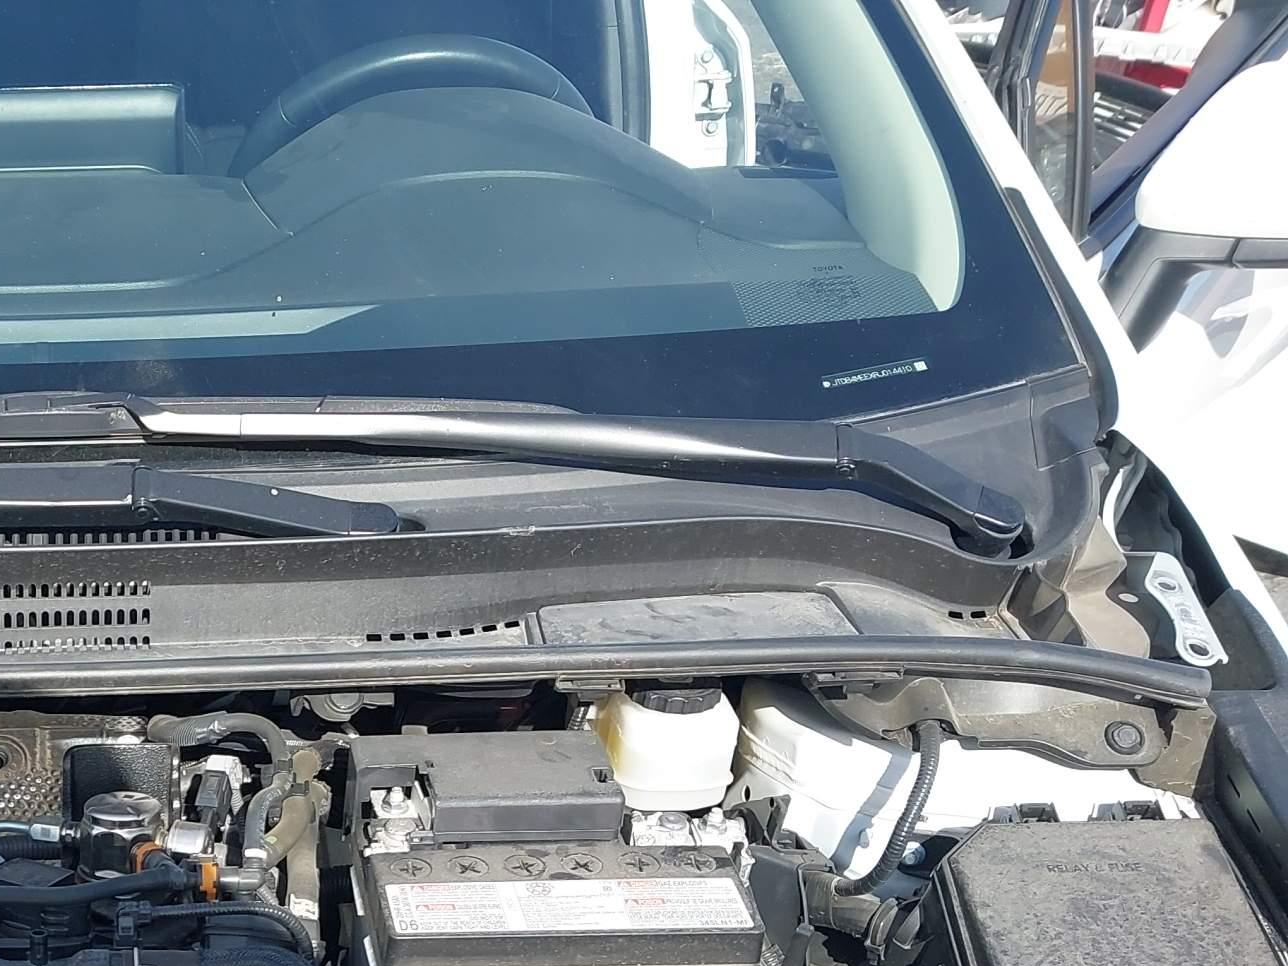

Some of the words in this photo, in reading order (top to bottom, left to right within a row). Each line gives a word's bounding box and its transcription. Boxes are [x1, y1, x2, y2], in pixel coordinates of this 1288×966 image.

[1047, 863, 1090, 874] RELAY
[1108, 862, 1144, 873] FUSE
[399, 919, 420, 931] D6
